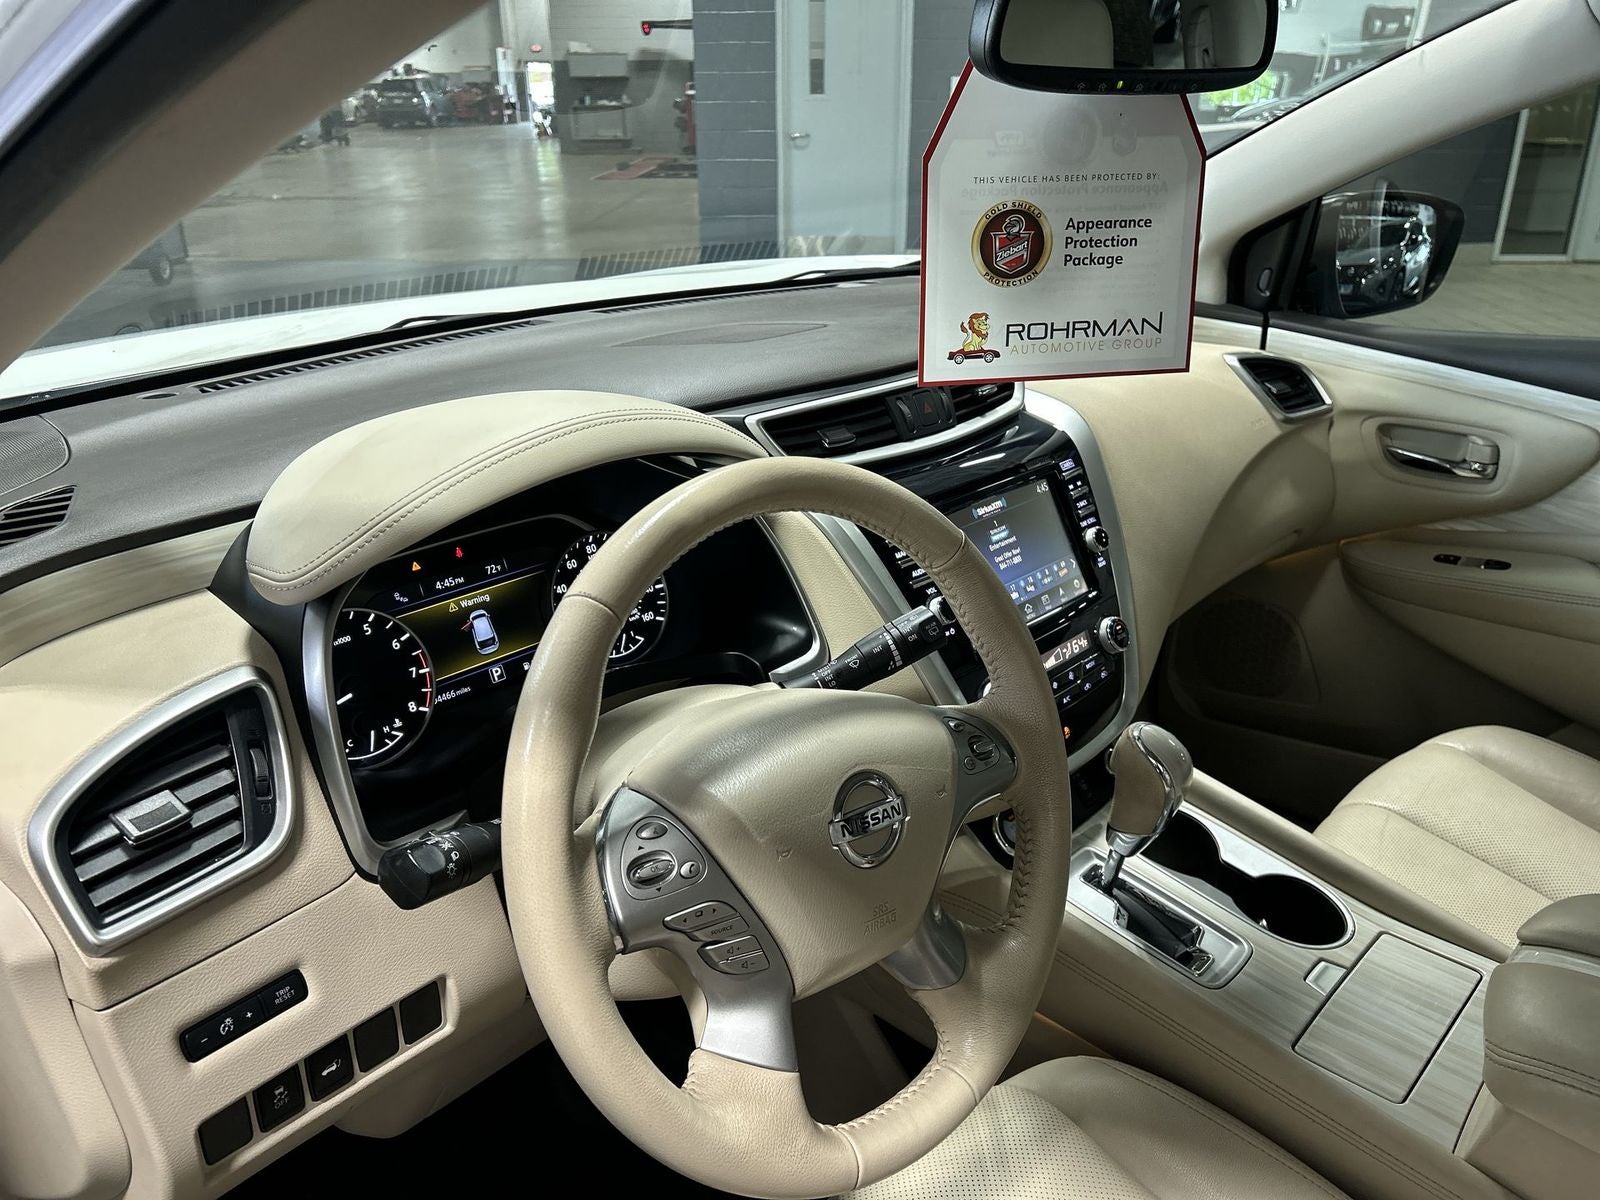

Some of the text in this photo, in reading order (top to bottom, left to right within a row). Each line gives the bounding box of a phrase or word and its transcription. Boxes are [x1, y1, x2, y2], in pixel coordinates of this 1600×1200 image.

[974, 172, 1160, 185] THIS VEHICLE HAS BEEN PROTECTED BY:
[985, 203, 1008, 220] GOLD
[1011, 201, 1042, 219] SHIELD
[1065, 217, 1153, 233] Appearance
[1065, 235, 1138, 249] Protection
[996, 241, 1028, 262] Ziebart
[1063, 252, 1123, 269] Package
[983, 269, 1039, 287] PROTECTION
[1005, 311, 1163, 347] ROHRMAN
[1010, 337, 1163, 355] AUTOMOTIVE GROUP
[585, 543, 597, 555] 80
[989, 535, 1017, 551] Entertainment
[566, 559, 578, 570] 60
[556, 583, 568, 594] 40
[926, 586, 938, 595] VOL
[460, 594, 490, 608] Warning
[641, 611, 654, 622] 160
[363, 623, 371, 635] 5
[391, 638, 400, 650] 6
[907, 633, 918, 642] ON
[872, 644, 883, 654] INT
[408, 666, 417, 679] 7
[491, 667, 501, 681] P
[456, 686, 471, 695] miles
[408, 701, 417, 713] 8
[383, 726, 390, 734] H
[347, 739, 354, 747] C
[840, 802, 902, 838] NISSAN
[650, 864, 661, 873] OK
[873, 901, 889, 917] SRS
[711, 925, 734, 936] SOURCE
[863, 913, 897, 936] AIRBAG
[274, 989, 295, 1004] RESET
[275, 986, 291, 998] TRIP
